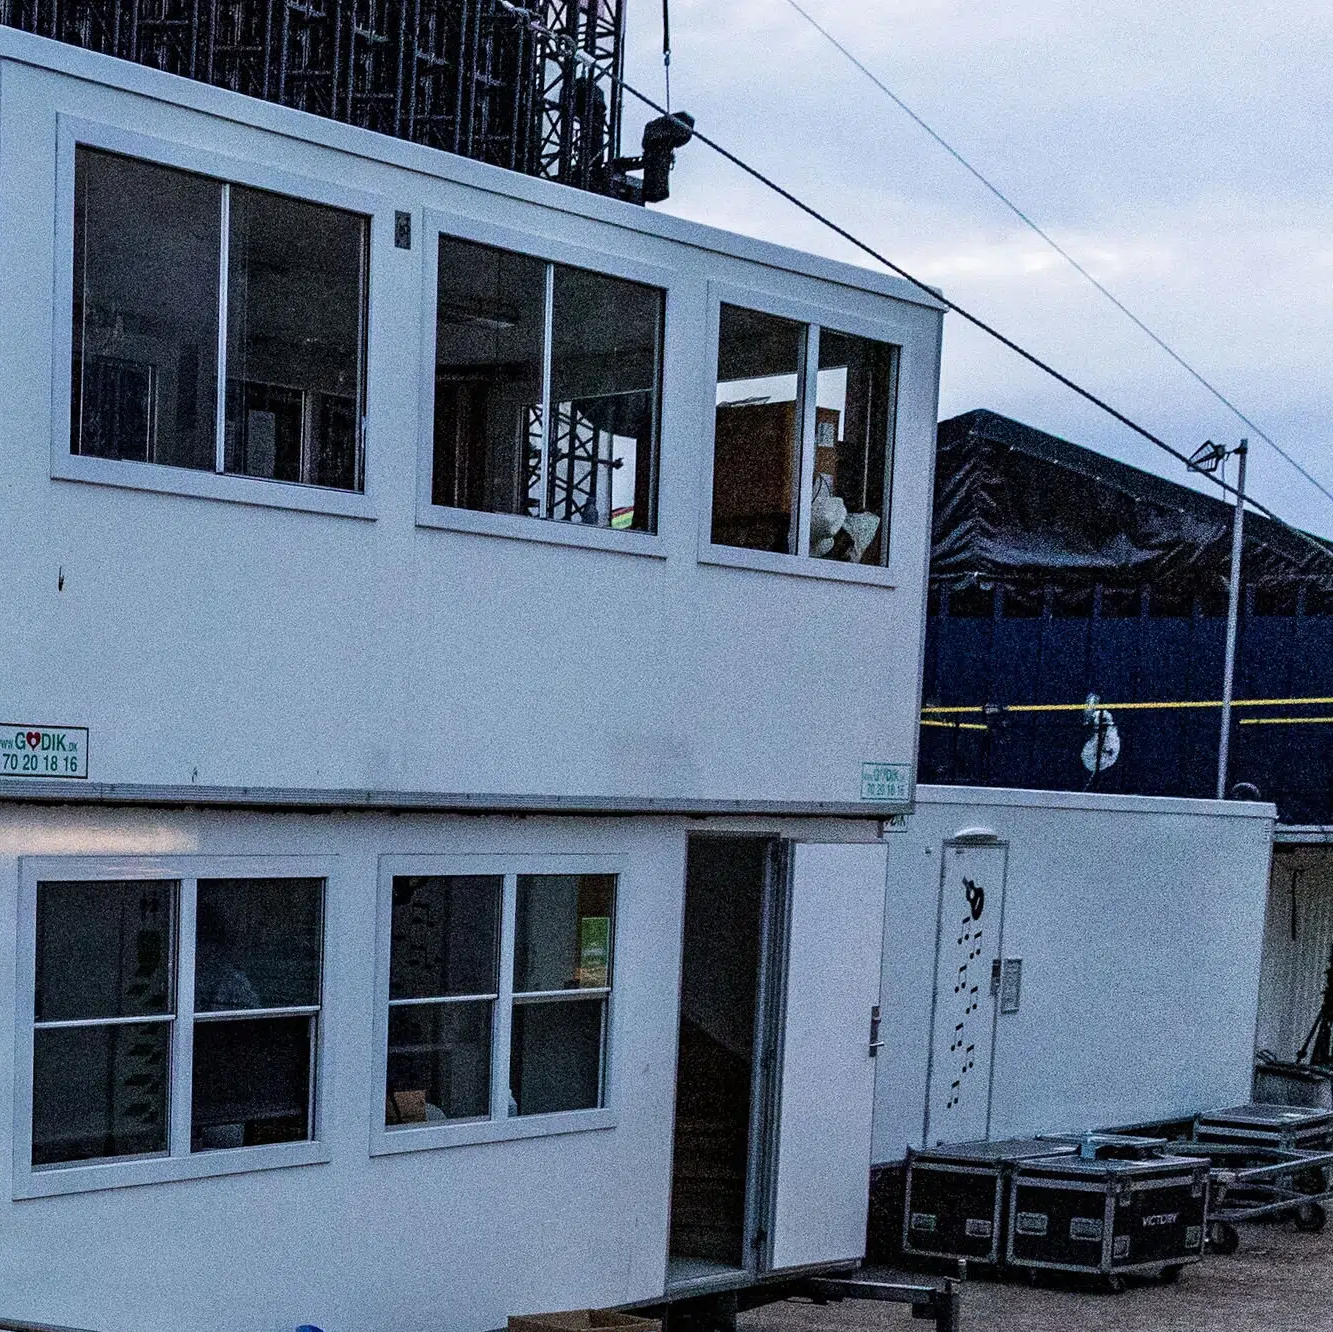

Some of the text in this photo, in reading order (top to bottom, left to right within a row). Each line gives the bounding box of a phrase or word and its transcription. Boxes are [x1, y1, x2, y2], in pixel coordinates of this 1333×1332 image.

[3, 753, 78, 772] 70 20 18 16
